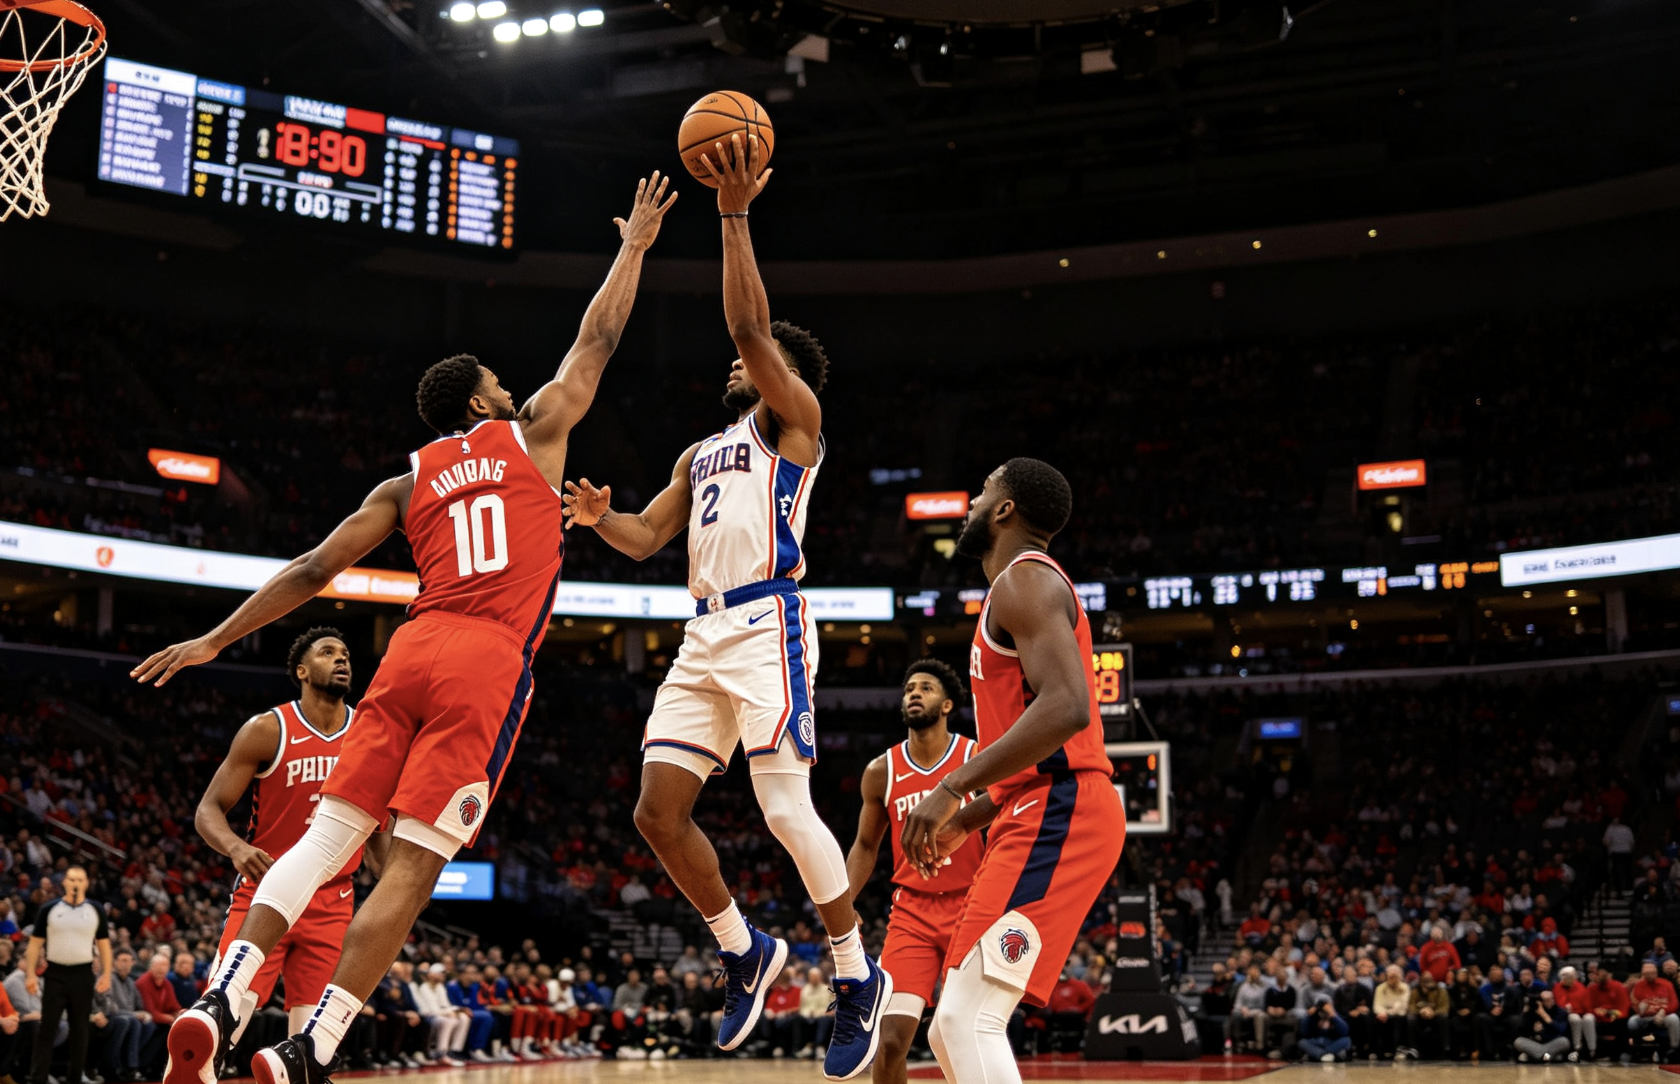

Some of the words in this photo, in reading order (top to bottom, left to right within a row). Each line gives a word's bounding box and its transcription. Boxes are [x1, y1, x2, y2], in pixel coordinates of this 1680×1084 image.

[701, 483, 720, 528] 2
[448, 493, 509, 577] 10
[1098, 1013, 1168, 1035] KIA
